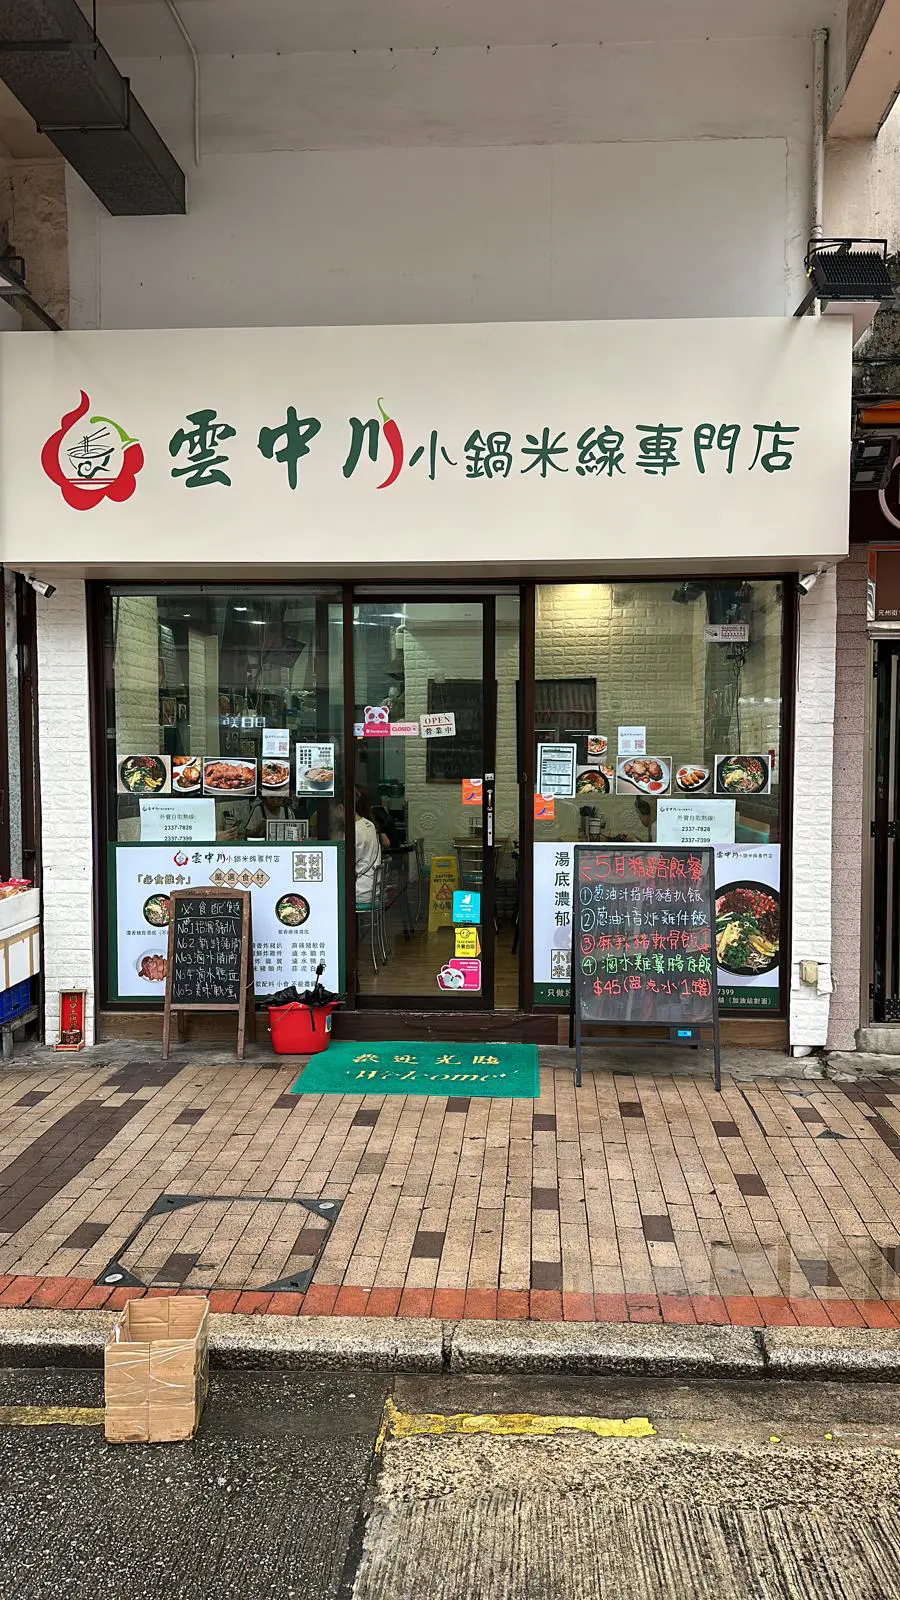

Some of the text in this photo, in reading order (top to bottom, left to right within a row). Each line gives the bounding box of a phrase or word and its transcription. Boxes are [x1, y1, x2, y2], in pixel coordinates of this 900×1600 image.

[169, 397, 800, 490] 雲中川 小鍋米線專門店
[424, 716, 451, 725] OPEN
[425, 726, 452, 736] 營業中
[554, 851, 571, 927] 湯底濃郁
